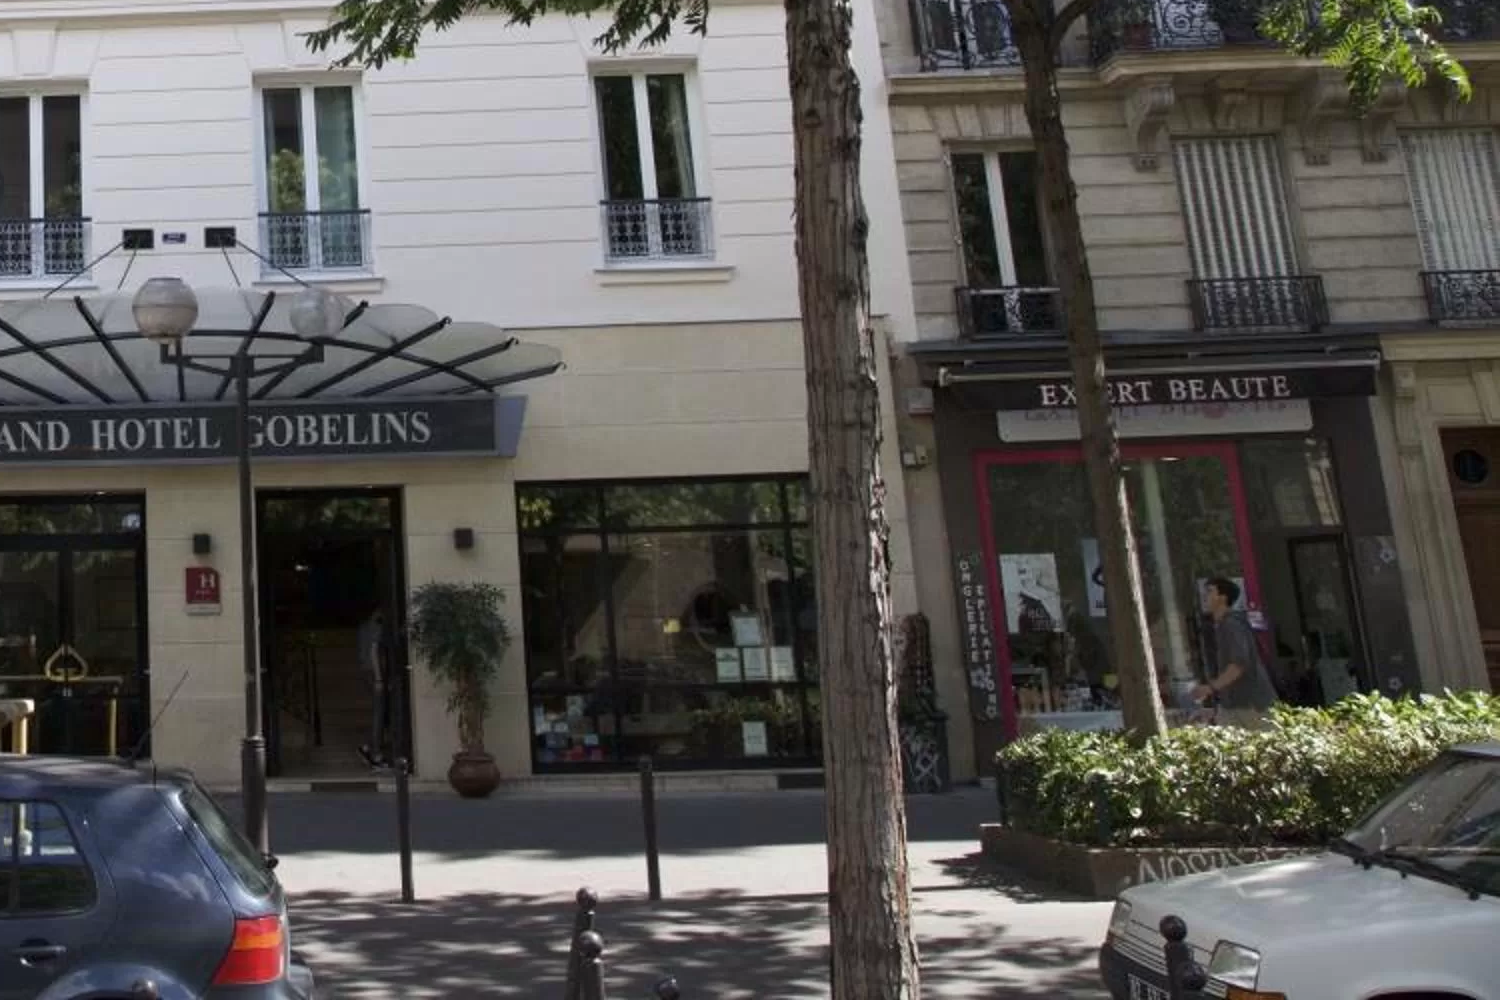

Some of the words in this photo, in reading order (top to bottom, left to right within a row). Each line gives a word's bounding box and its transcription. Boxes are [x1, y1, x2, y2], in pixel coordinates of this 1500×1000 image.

[1038, 381, 1153, 406] EXERT
[1168, 375, 1292, 402] BEAUTE
[91, 416, 222, 451] HOTEL
[245, 410, 433, 447] GOBELINS
